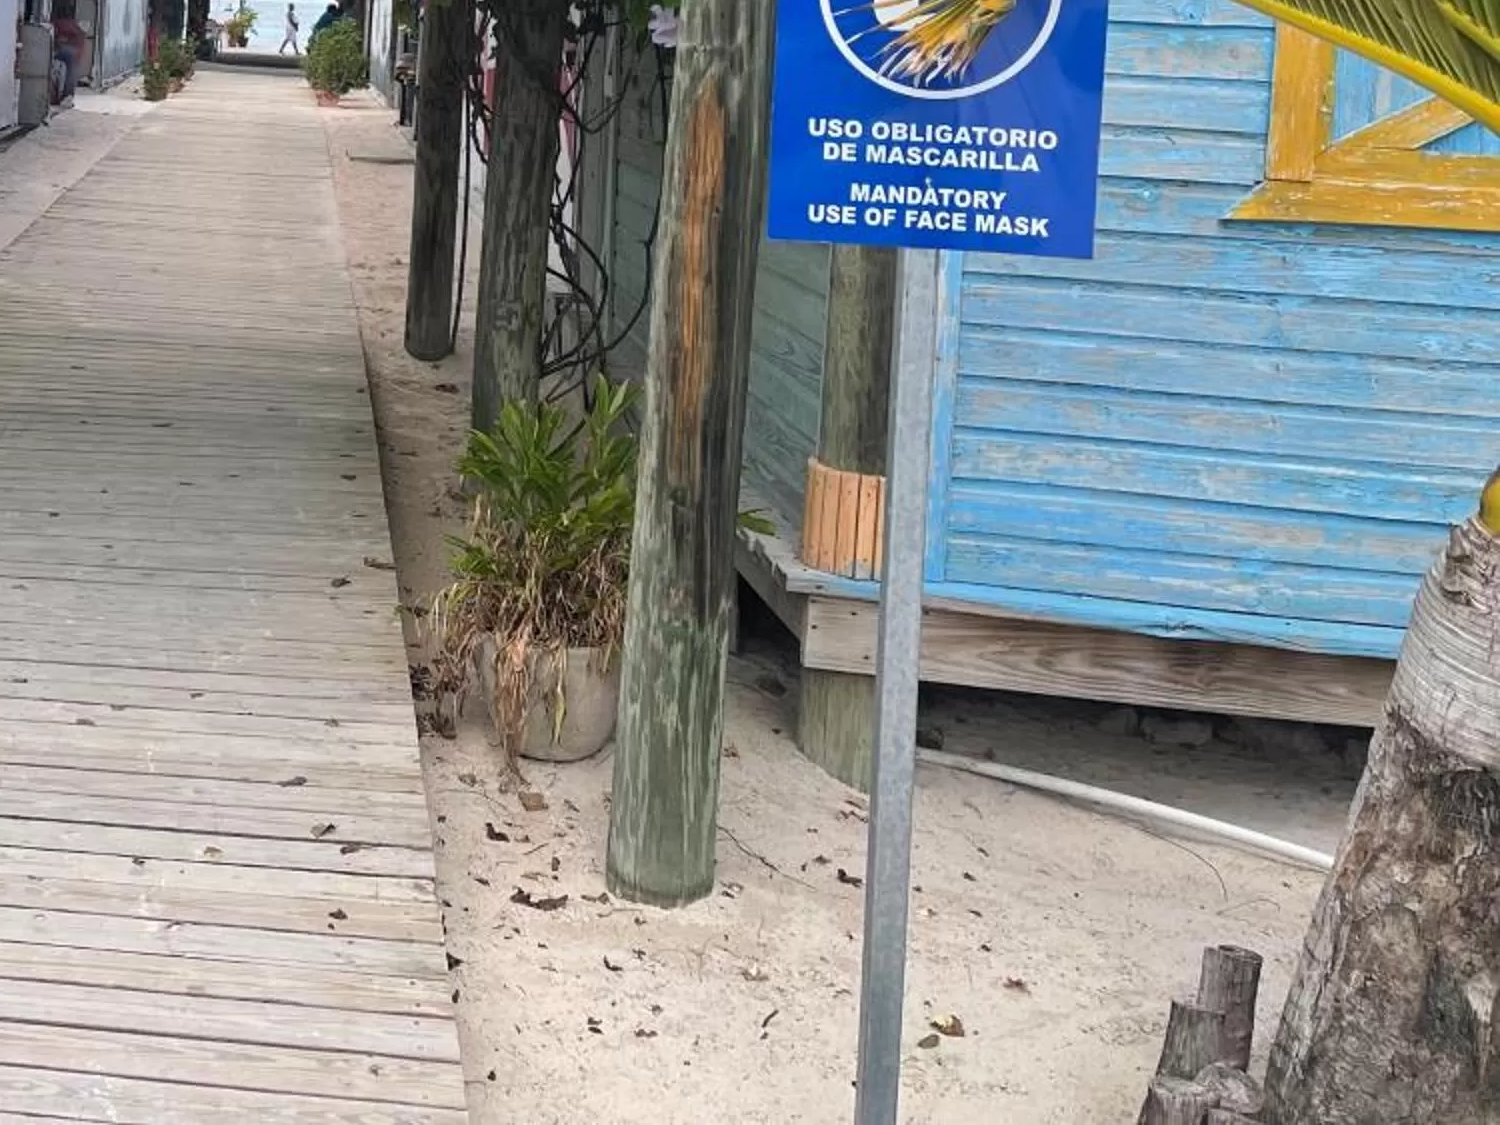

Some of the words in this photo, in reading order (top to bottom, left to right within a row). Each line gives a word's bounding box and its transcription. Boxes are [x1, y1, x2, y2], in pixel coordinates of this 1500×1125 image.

[808, 118, 863, 138] USO
[871, 121, 1058, 150] OBLIGATORIO
[823, 142, 857, 162] DE
[865, 144, 1040, 172] MASCARILLA
[850, 183, 1007, 210] MANDATORY
[808, 204, 857, 224] USE
[864, 207, 897, 226] OF
[905, 210, 967, 231] FACE
[975, 214, 1049, 238] MASK
